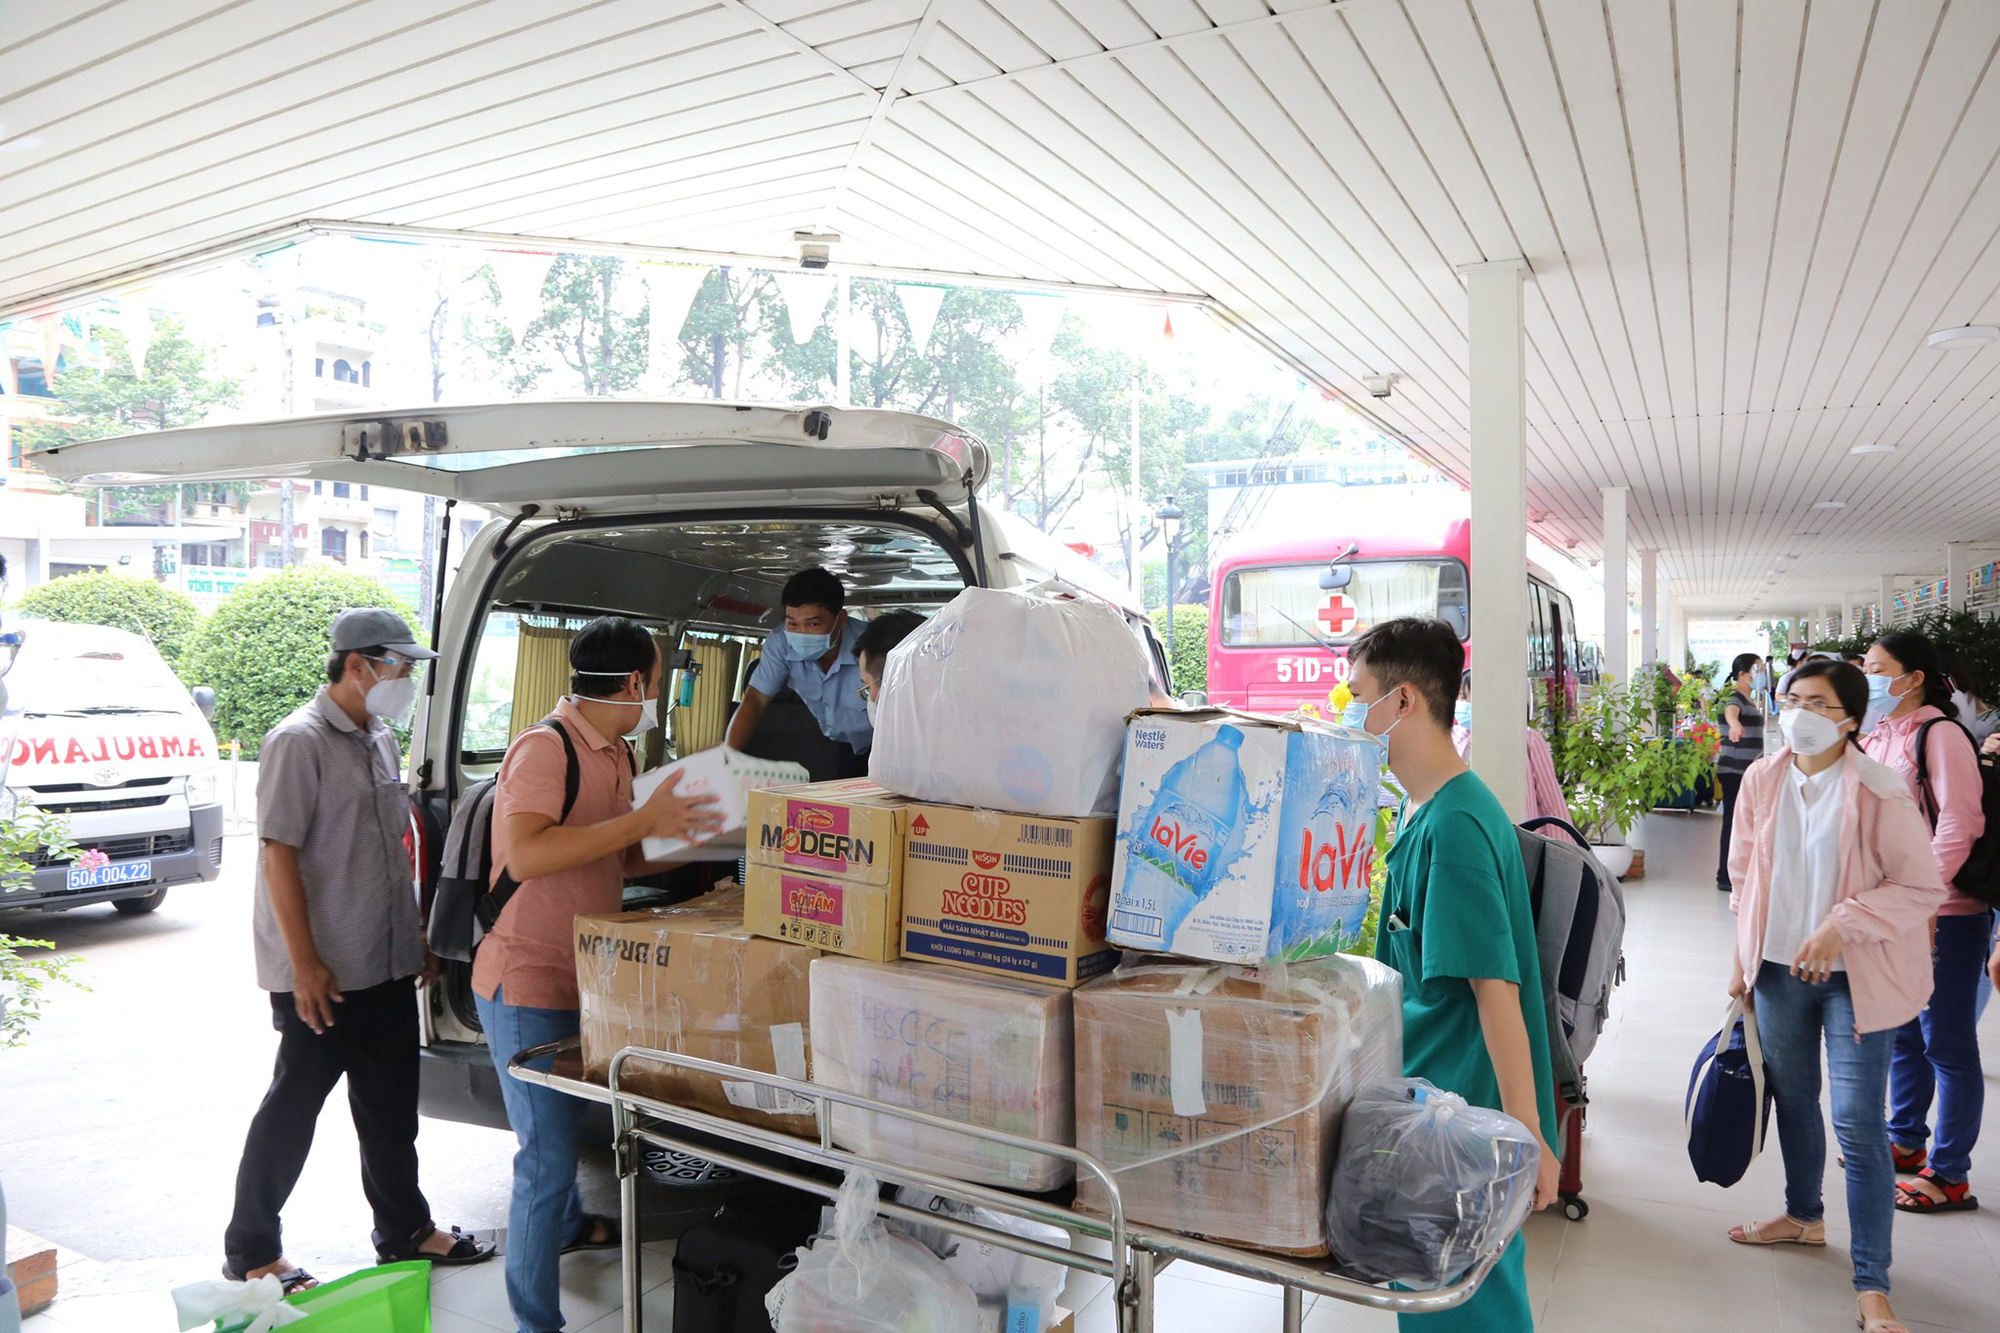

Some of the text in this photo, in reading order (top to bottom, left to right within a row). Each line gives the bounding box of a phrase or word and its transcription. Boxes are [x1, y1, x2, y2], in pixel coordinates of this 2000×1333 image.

[1135, 729, 1167, 741] Nestlé
[1135, 740, 1165, 750] Waters
[761, 823, 874, 865] MODERN
[974, 853, 997, 864] NISSIN
[70, 863, 148, 887] 50A-004.22
[961, 872, 1010, 898] CUP
[942, 890, 1026, 925] NOODLES
[1115, 892, 1121, 904] 12
[1135, 899, 1139, 908] x
[943, 921, 954, 931] HẢI
[956, 923, 969, 933] SẢN
[970, 926, 989, 938] NHẬT
[990, 929, 1005, 940] BẢN
[579, 933, 672, 968] B BRAUN
[931, 942, 943, 951] KHỐI
[944, 945, 961, 955] LƯỢNG
[962, 948, 976, 957] TỊNH:
[993, 953, 1001, 963] kg
[1001, 955, 1011, 963] (24
[1023, 958, 1030, 967] 67
[1130, 1072, 1156, 1094] MPV
[1214, 1082, 1262, 1109] TUBING
